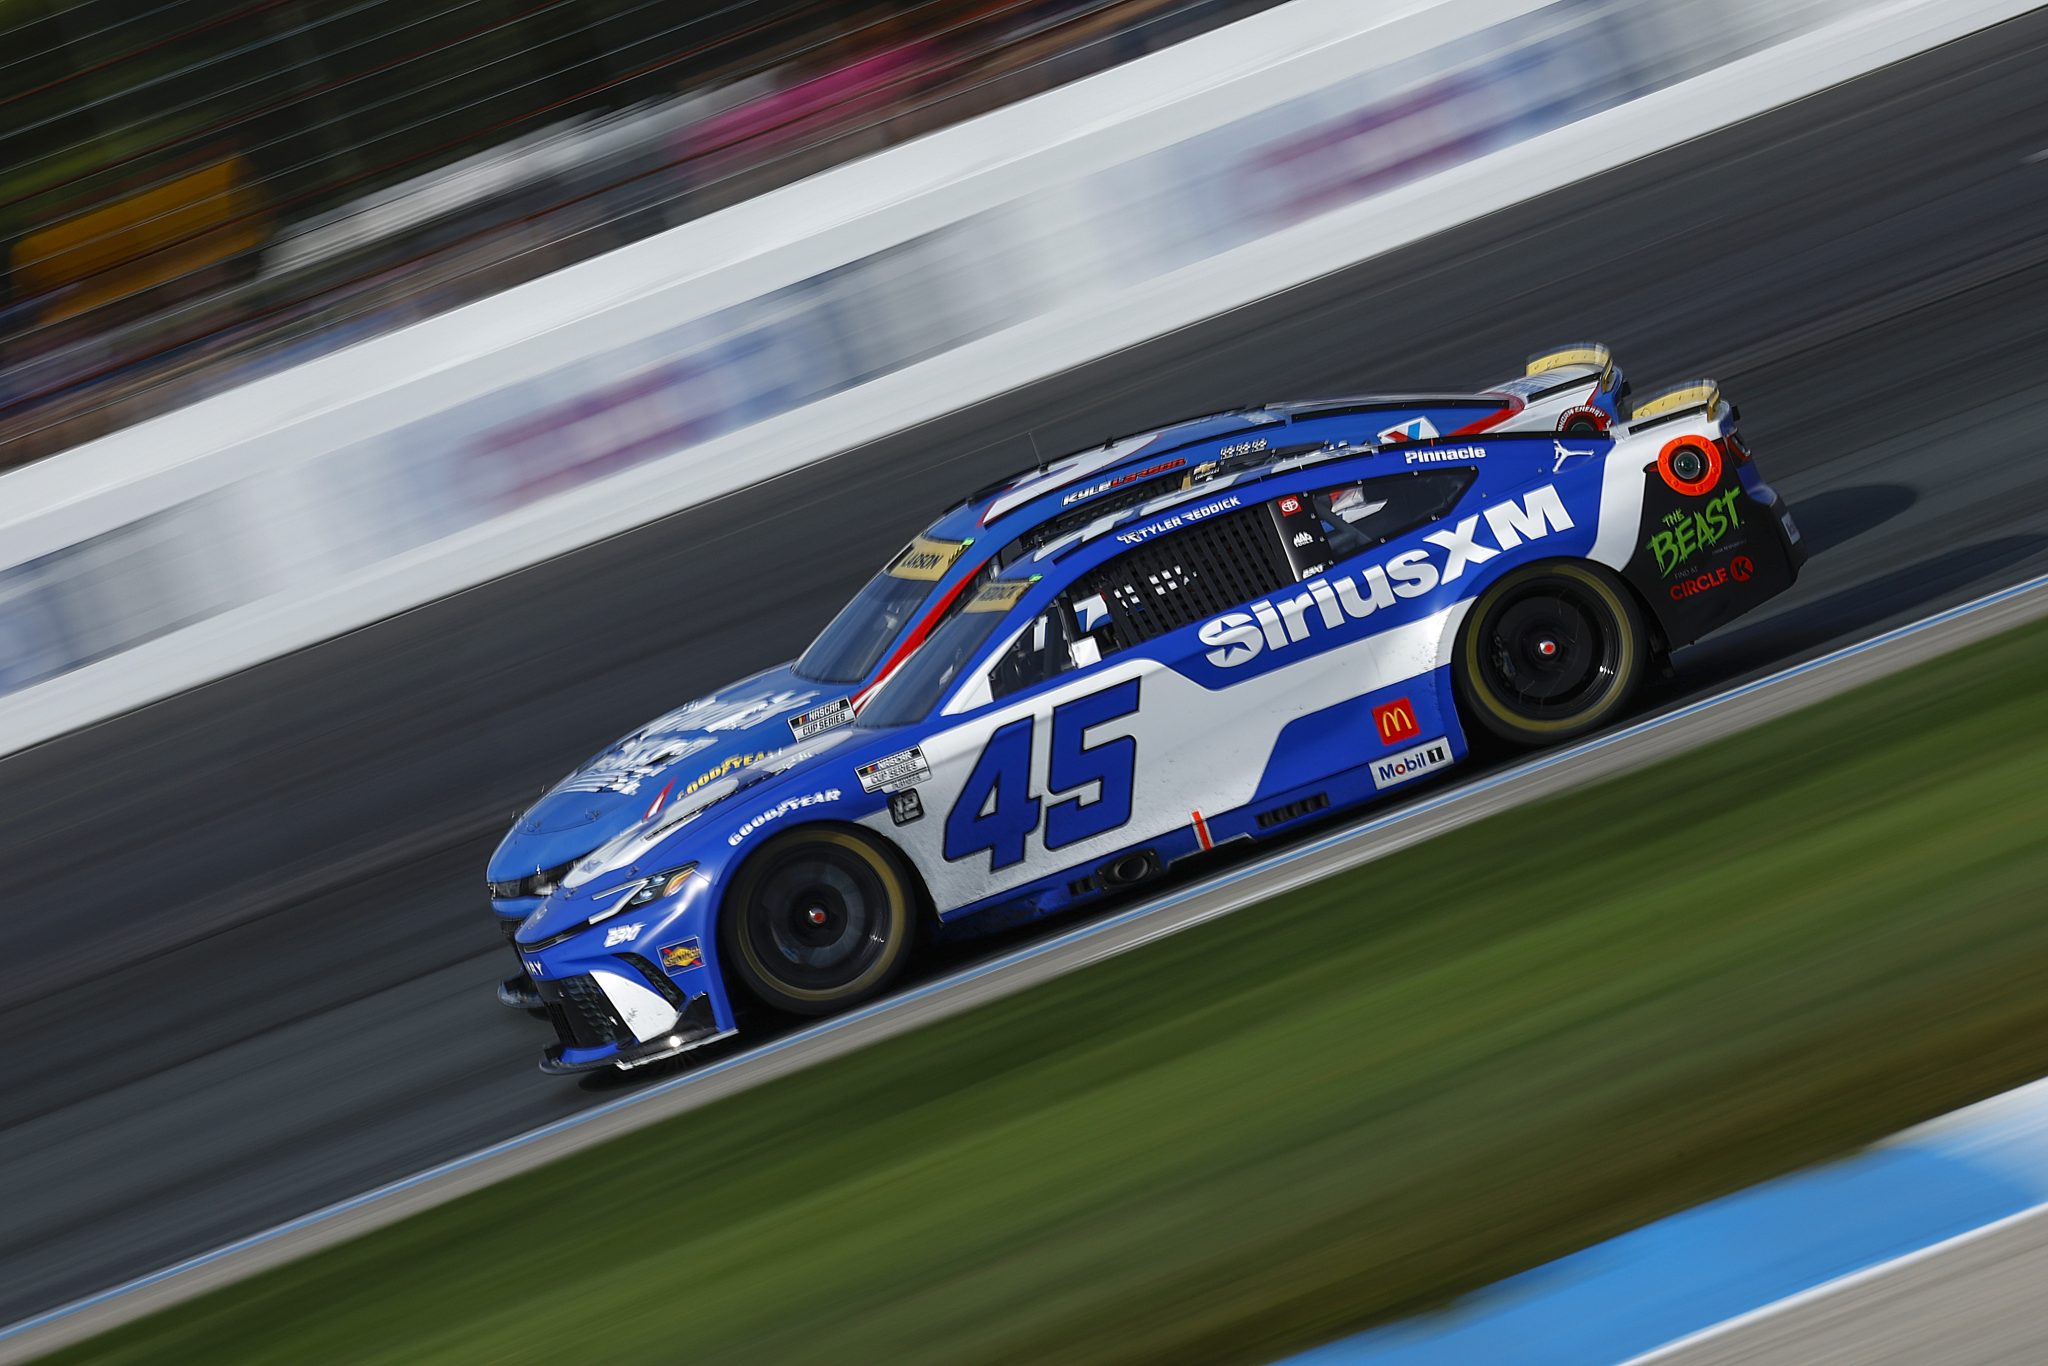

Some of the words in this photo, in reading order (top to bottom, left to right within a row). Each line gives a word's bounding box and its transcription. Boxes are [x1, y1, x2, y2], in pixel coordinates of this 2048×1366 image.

[1574, 406, 1605, 418] ENERGY
[1404, 445, 1487, 464] Pinnacle
[1061, 481, 1112, 508] KYLE
[1139, 515, 1184, 539] TYLER
[1181, 496, 1241, 521] REDDICK
[1662, 506, 1685, 527] THE
[1646, 486, 1741, 579] BEAST
[1670, 567, 1729, 601] CIRCLE
[1733, 556, 1754, 581] K
[802, 722, 819, 736] CUP
[818, 712, 847, 731] SERIES
[808, 701, 841, 722] NASCAR
[876, 751, 913, 771] NASCAR
[943, 674, 1142, 874] 45
[1378, 752, 1427, 781] Mobil
[727, 788, 842, 847] GOODYEAR
